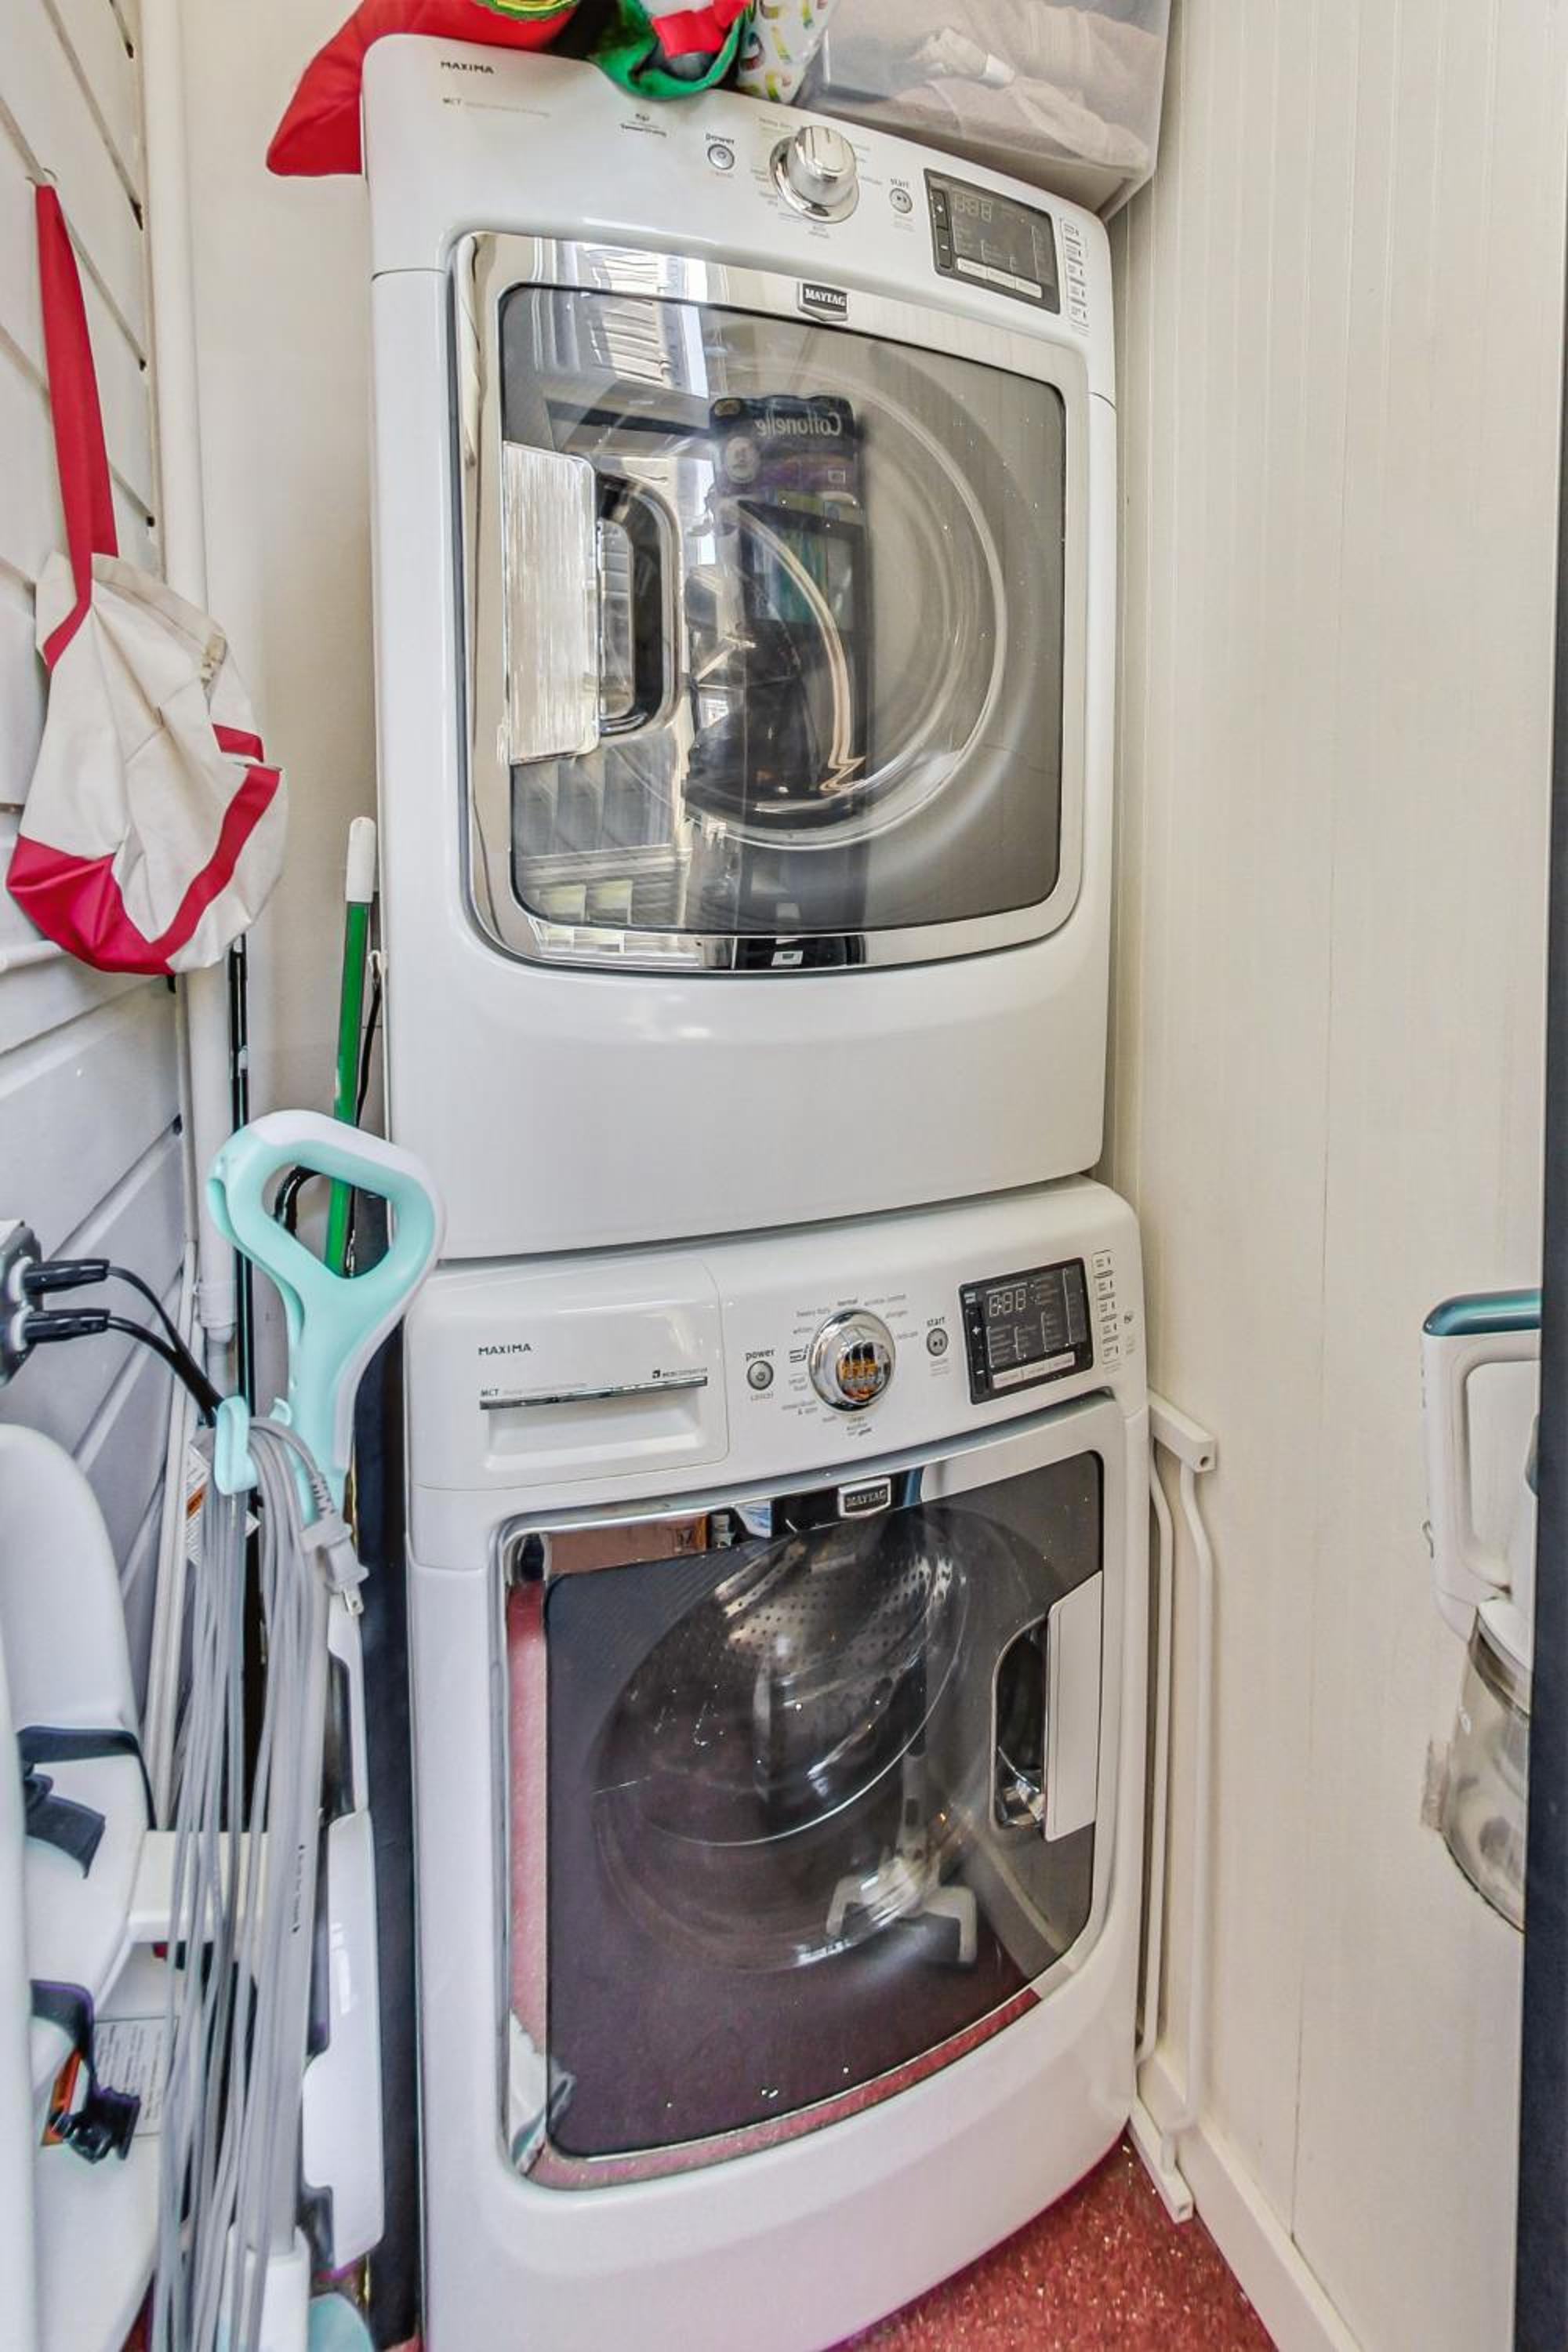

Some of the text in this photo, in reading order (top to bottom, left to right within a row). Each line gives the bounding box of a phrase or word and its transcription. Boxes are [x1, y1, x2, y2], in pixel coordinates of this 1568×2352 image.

[440, 61, 495, 74] MAXIMA
[805, 289, 846, 307] MAYTAG
[926, 1316, 946, 1327] start
[478, 1343, 532, 1356] MAXIMA
[745, 1348, 775, 1362] power
[845, 1488, 887, 1508] MAYTAG
